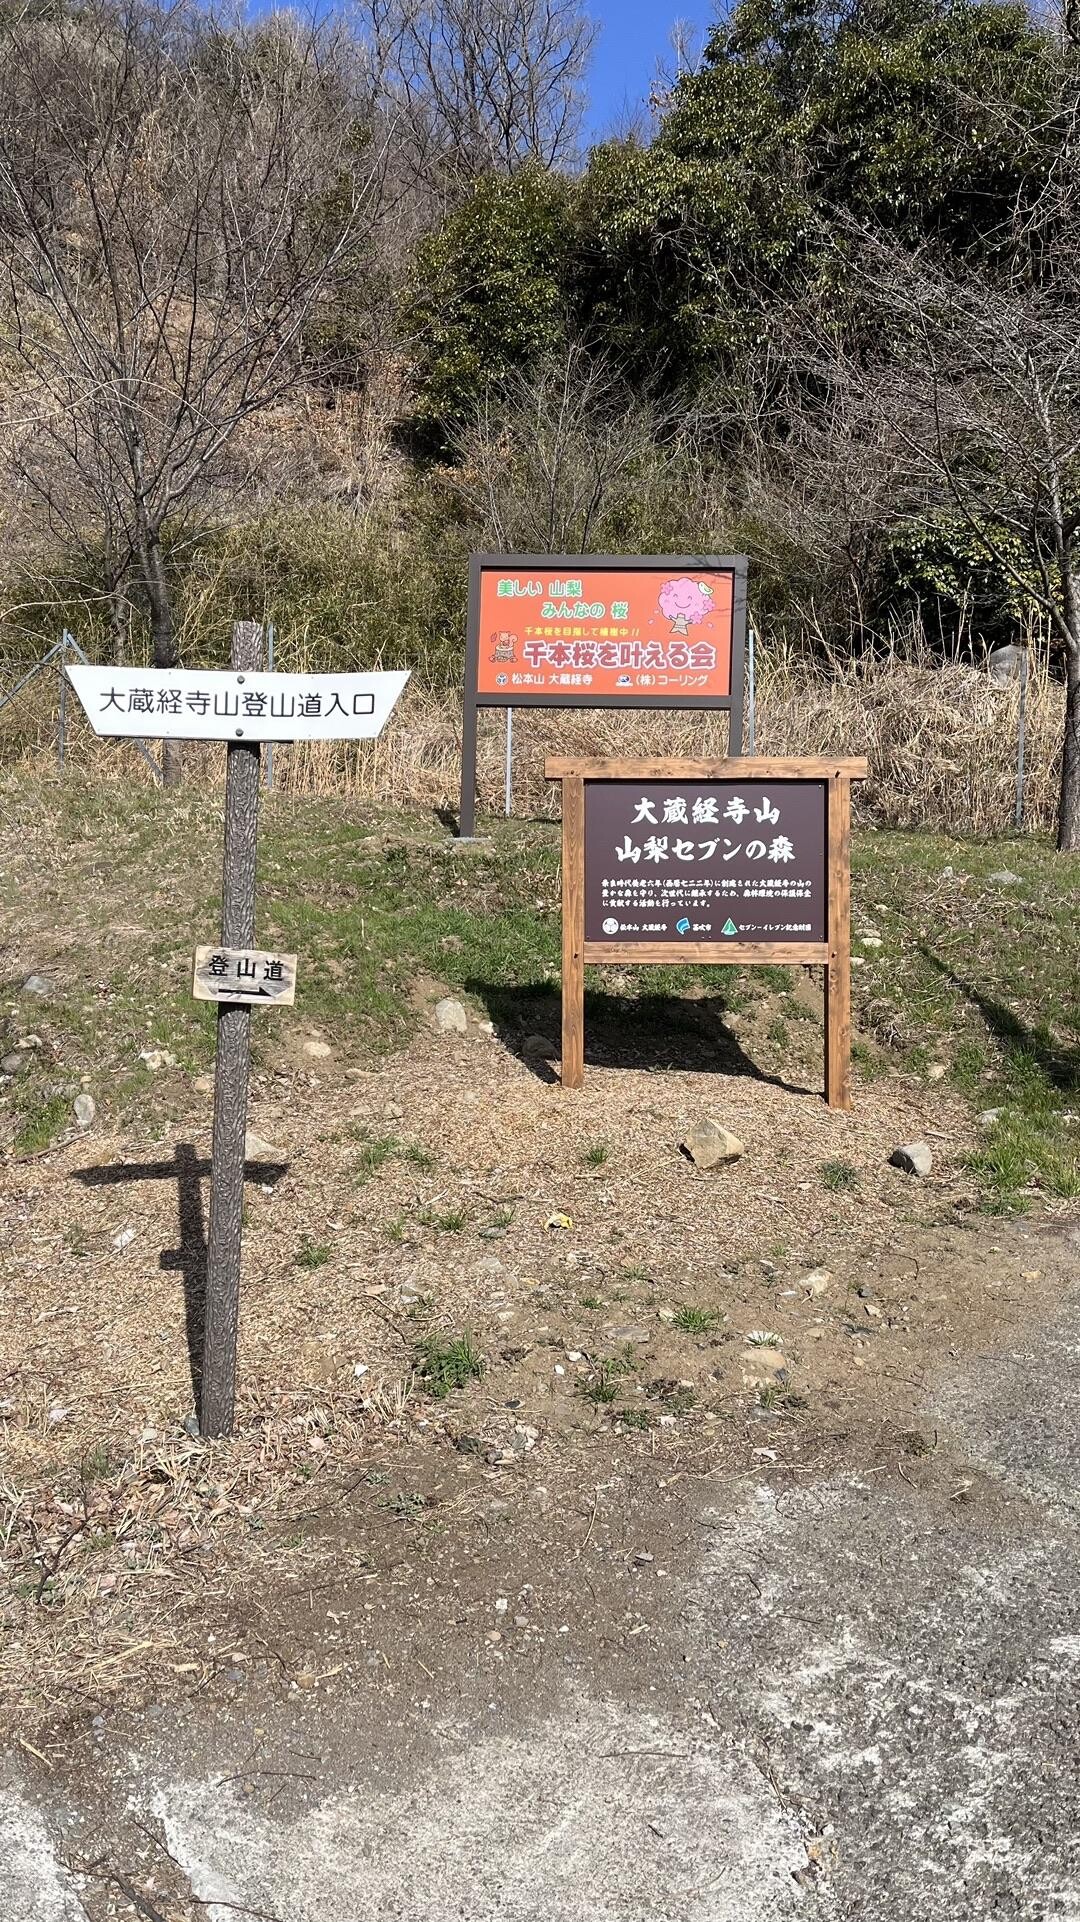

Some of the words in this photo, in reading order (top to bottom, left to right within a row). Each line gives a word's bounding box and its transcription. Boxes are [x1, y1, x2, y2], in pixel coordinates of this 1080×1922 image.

[497, 579, 542, 597] 美しい
[548, 579, 583, 597] 山梨
[541, 601, 605, 619] みんなの
[611, 601, 629, 619] 桜
[523, 640, 717, 670] 千本桜を叶える会
[512, 673, 545, 685] 松本山
[549, 673, 593, 686] 大蔵経寺
[99, 686, 375, 718] 大蔵経寺山登山道入口
[630, 796, 781, 825] 大蔵経寺山
[614, 835, 796, 864] 山梨セブンの森
[208, 955, 284, 981] 登山道
